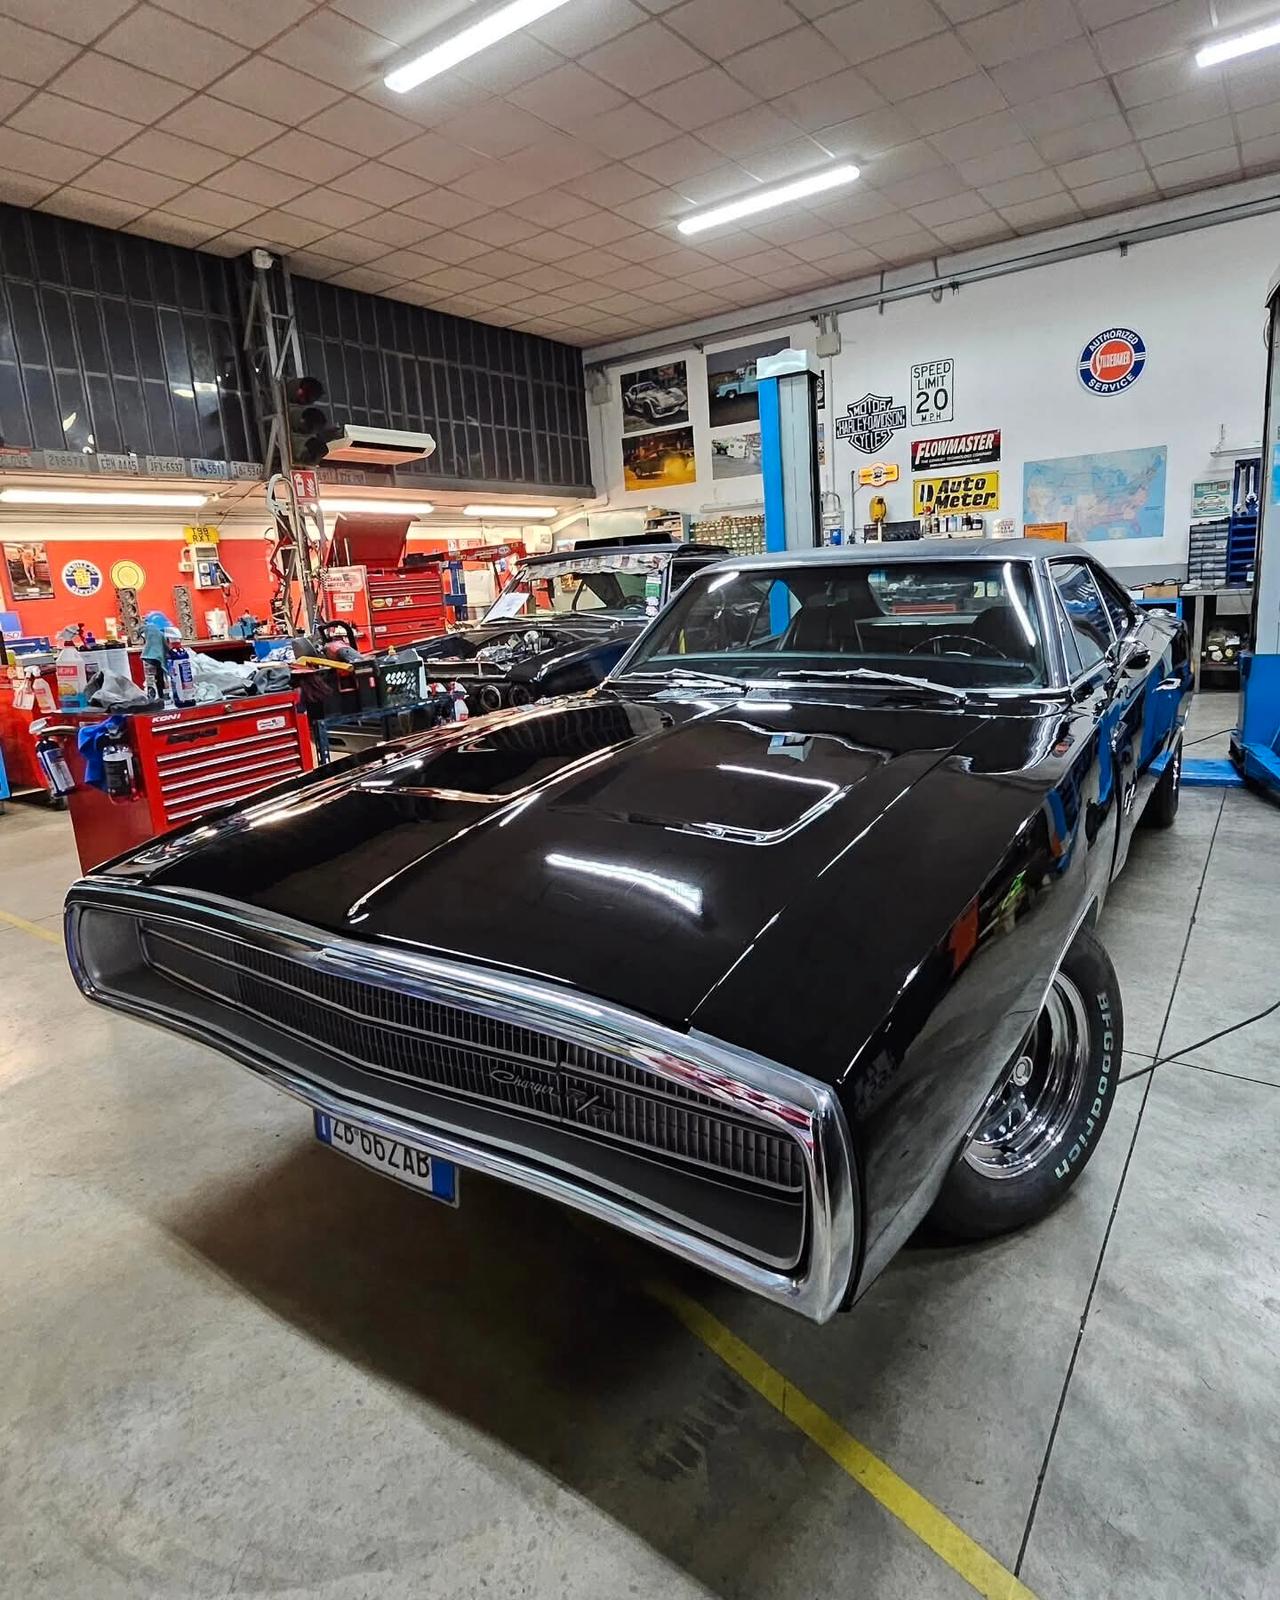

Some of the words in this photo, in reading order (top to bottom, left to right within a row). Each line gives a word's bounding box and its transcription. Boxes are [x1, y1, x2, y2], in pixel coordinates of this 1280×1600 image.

[1089, 330, 1139, 352] AUTHORIZED
[913, 361, 951, 379] SPEED
[917, 375, 946, 390] LIMIT
[1088, 373, 1135, 392] SERVICE
[853, 400, 887, 416] MOTOR
[916, 388, 948, 414] 20
[854, 430, 888, 449] CYCLES
[914, 433, 995, 465] FLOWMASTER
[937, 477, 986, 494] Auto
[935, 492, 996, 509] Meter
[151, 713, 181, 723] KONI
[489, 1070, 554, 1095] Charger
